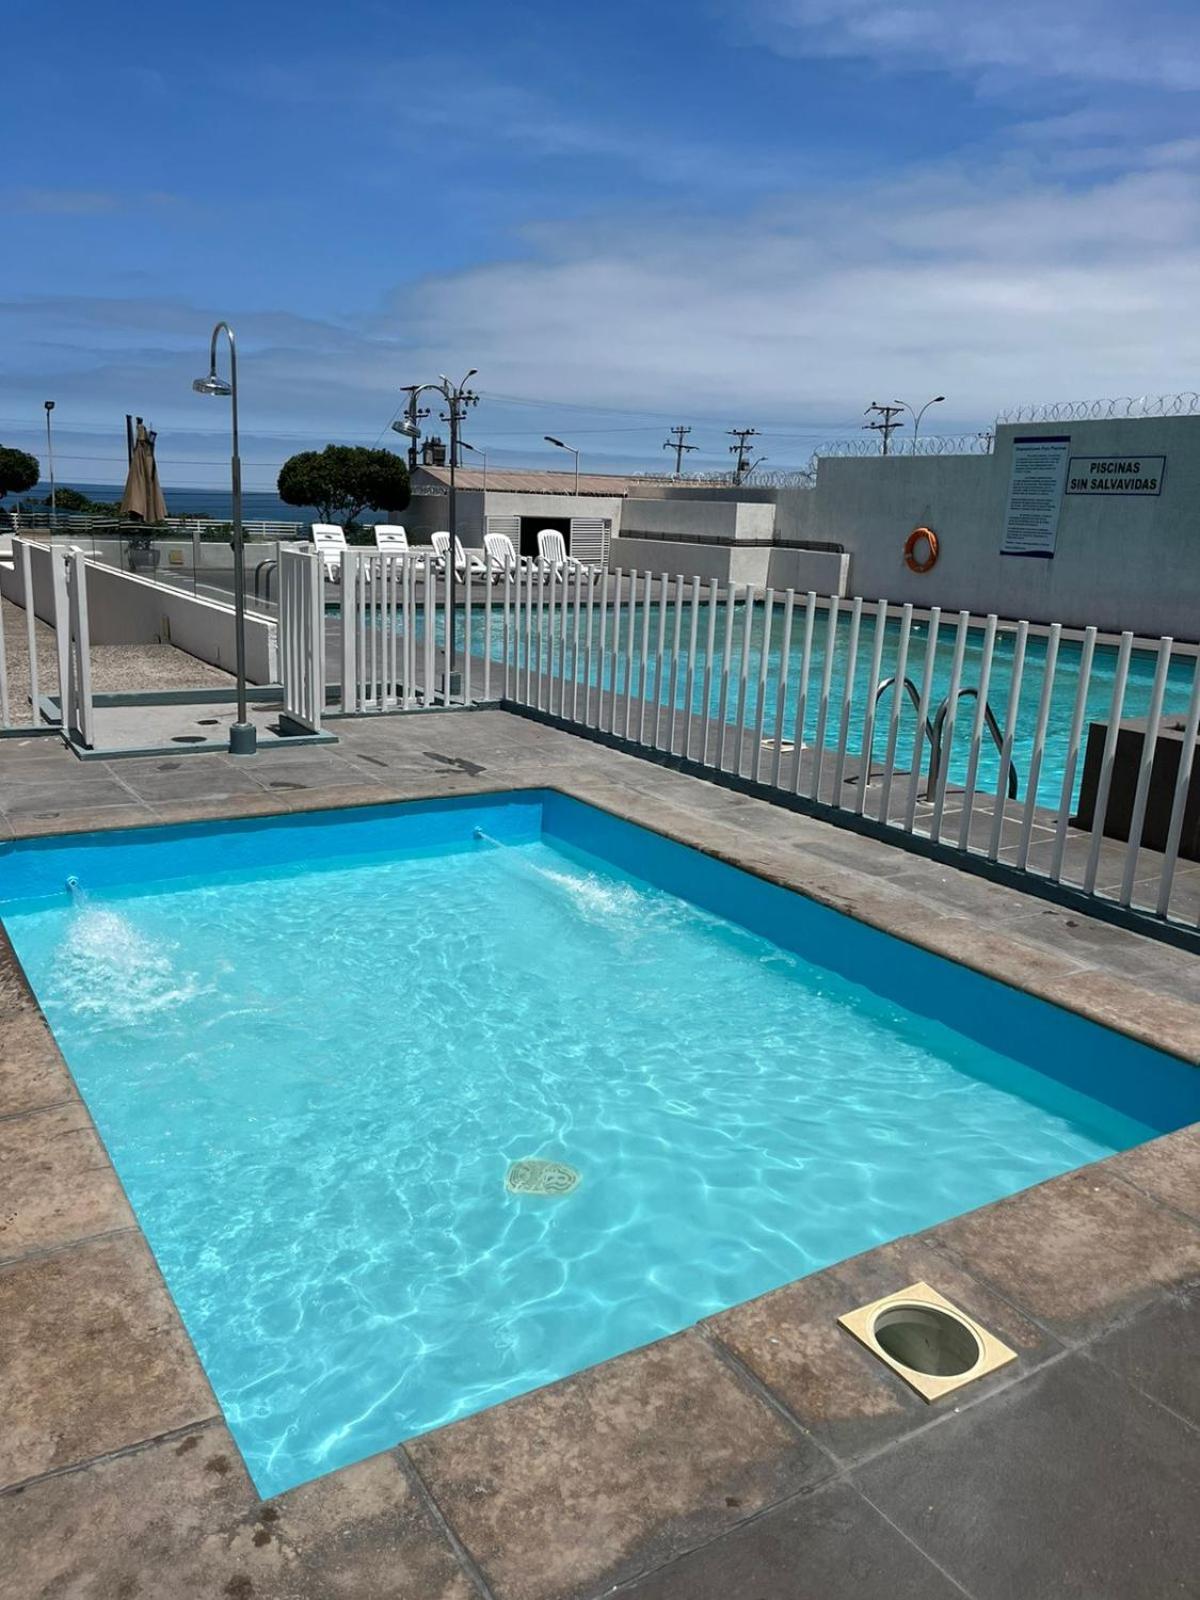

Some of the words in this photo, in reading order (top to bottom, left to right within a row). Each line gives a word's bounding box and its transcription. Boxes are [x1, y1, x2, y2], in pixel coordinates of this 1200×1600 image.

[1090, 462, 1141, 474] PISCINAS
[1071, 478, 1088, 490] SIN
[1090, 478, 1157, 490] SALVAVIDAS
